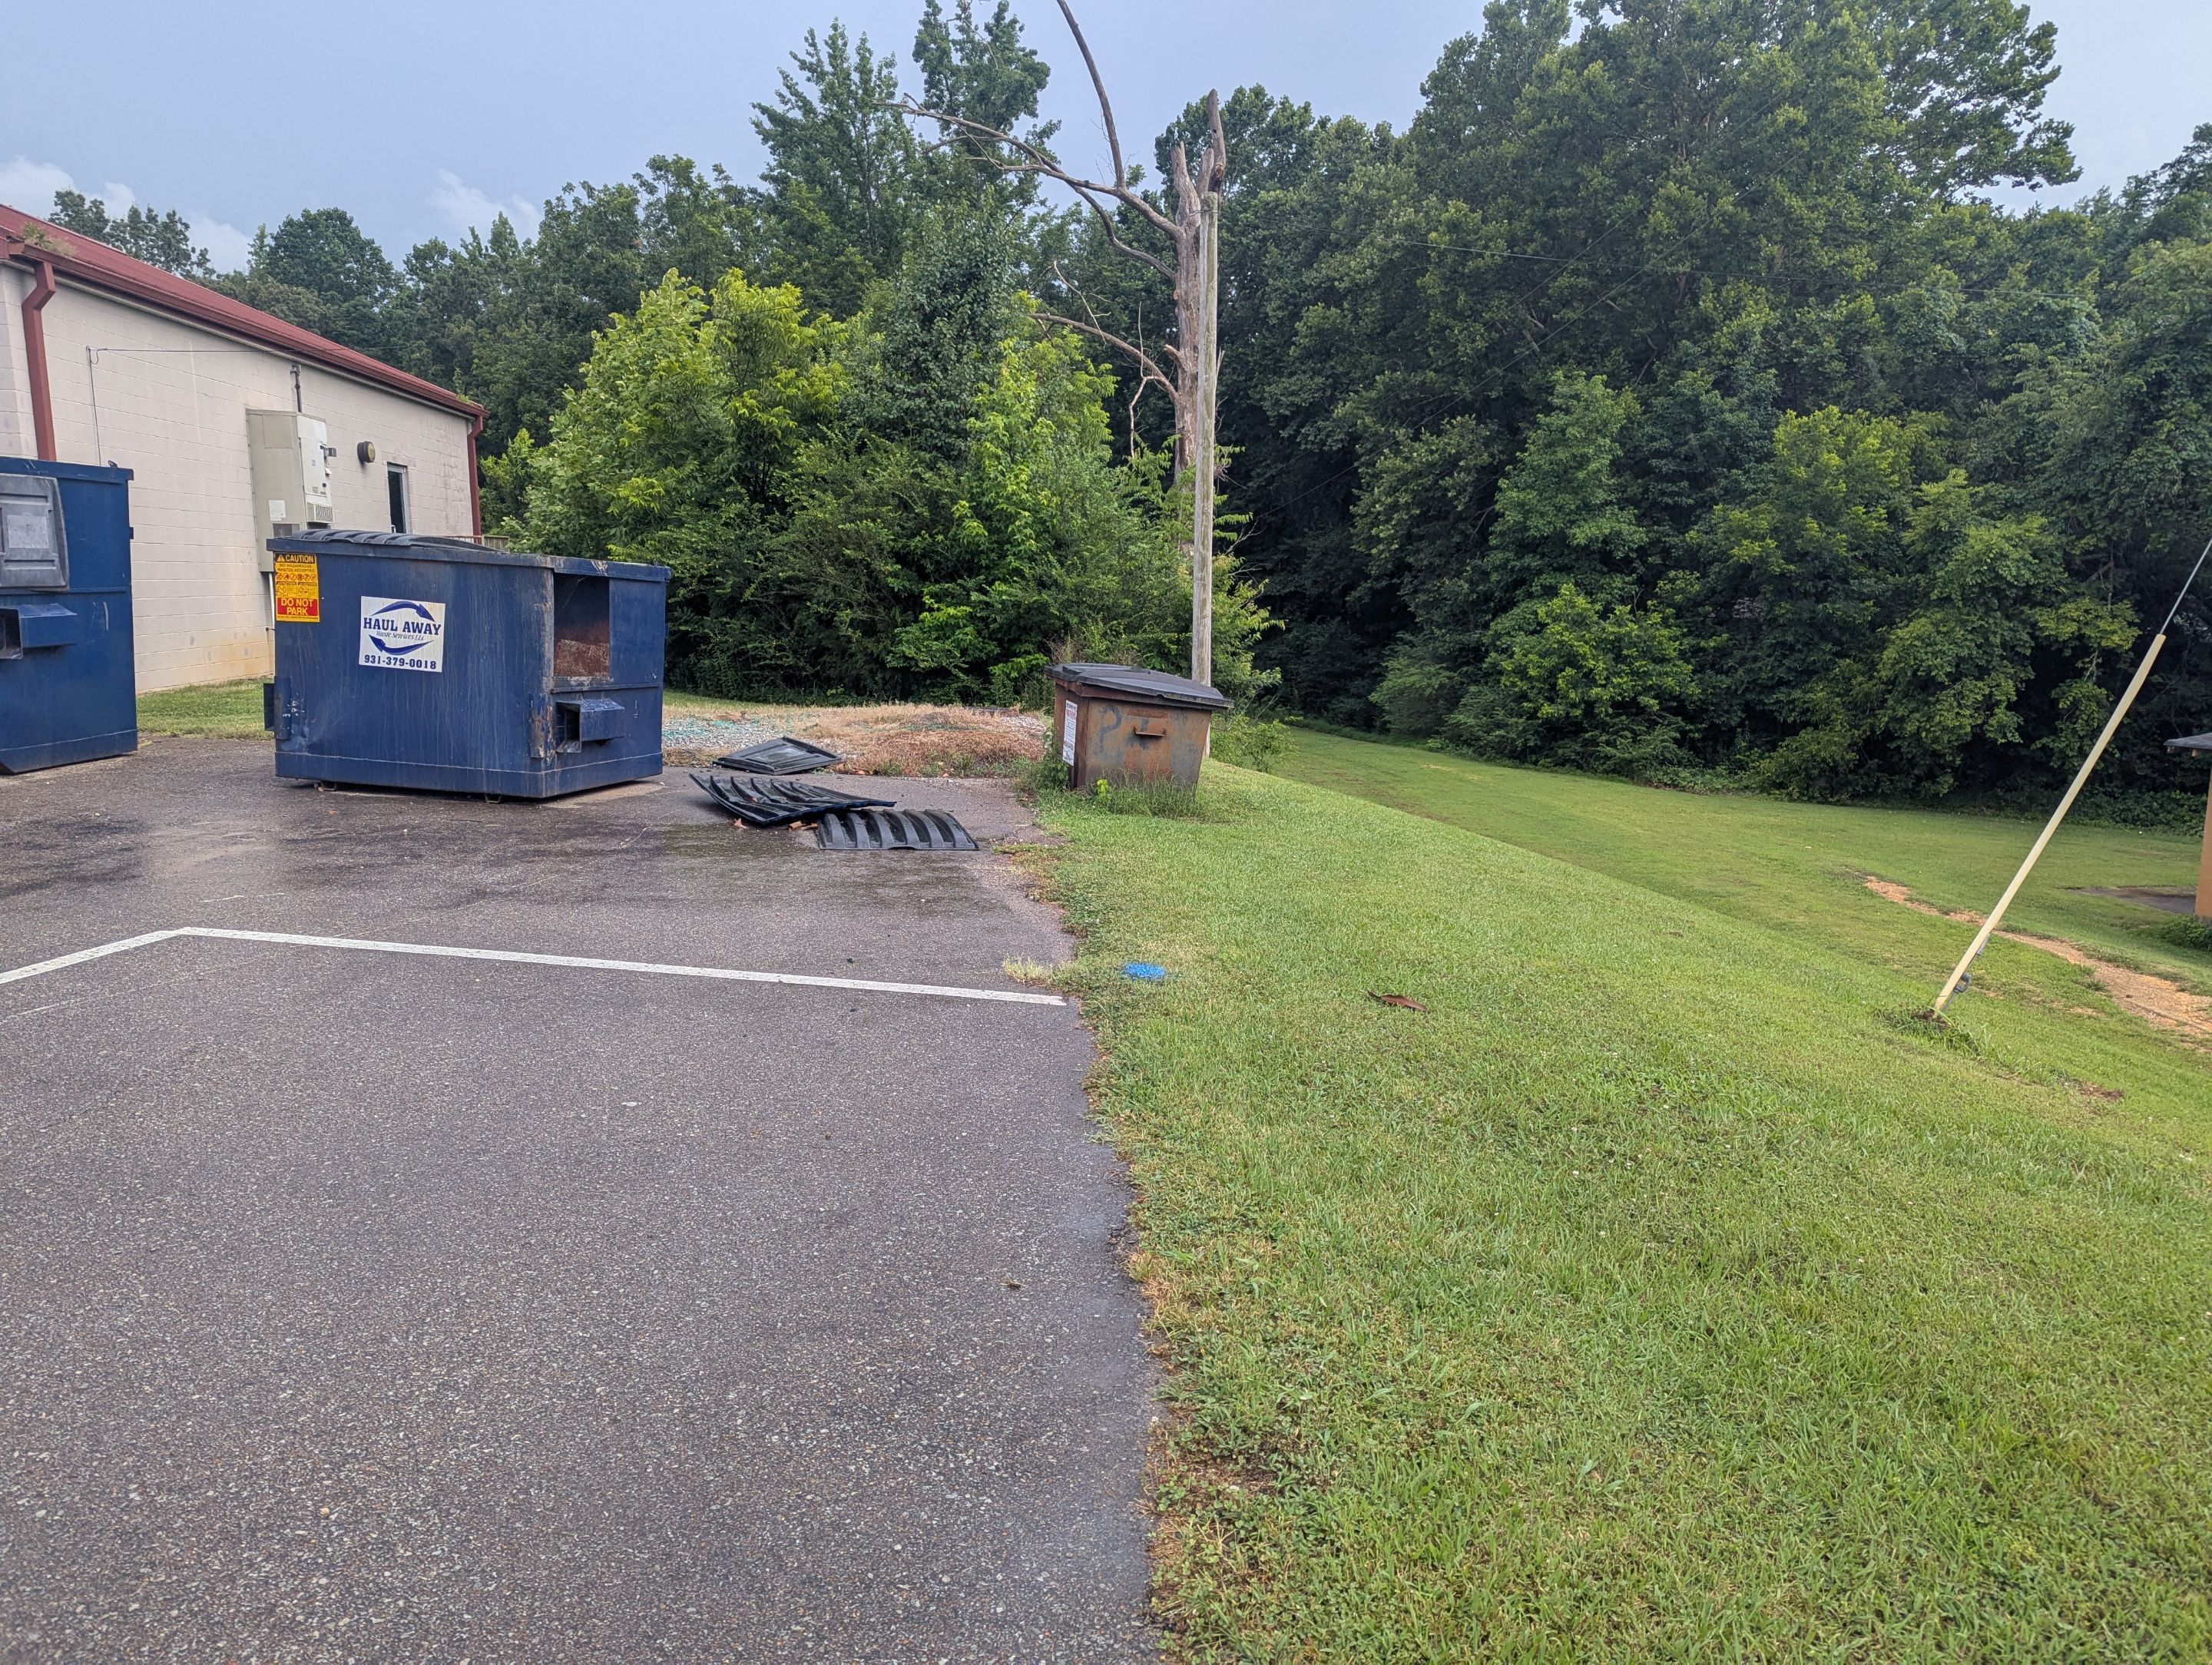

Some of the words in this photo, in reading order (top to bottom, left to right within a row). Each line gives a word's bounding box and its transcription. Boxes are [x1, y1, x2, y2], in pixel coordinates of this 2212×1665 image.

[286, 607, 308, 616] PARK
[363, 617, 398, 631] HAUL
[402, 621, 441, 635] AWAY
[392, 632, 414, 641] Services
[364, 655, 436, 669] 931-379-0018
